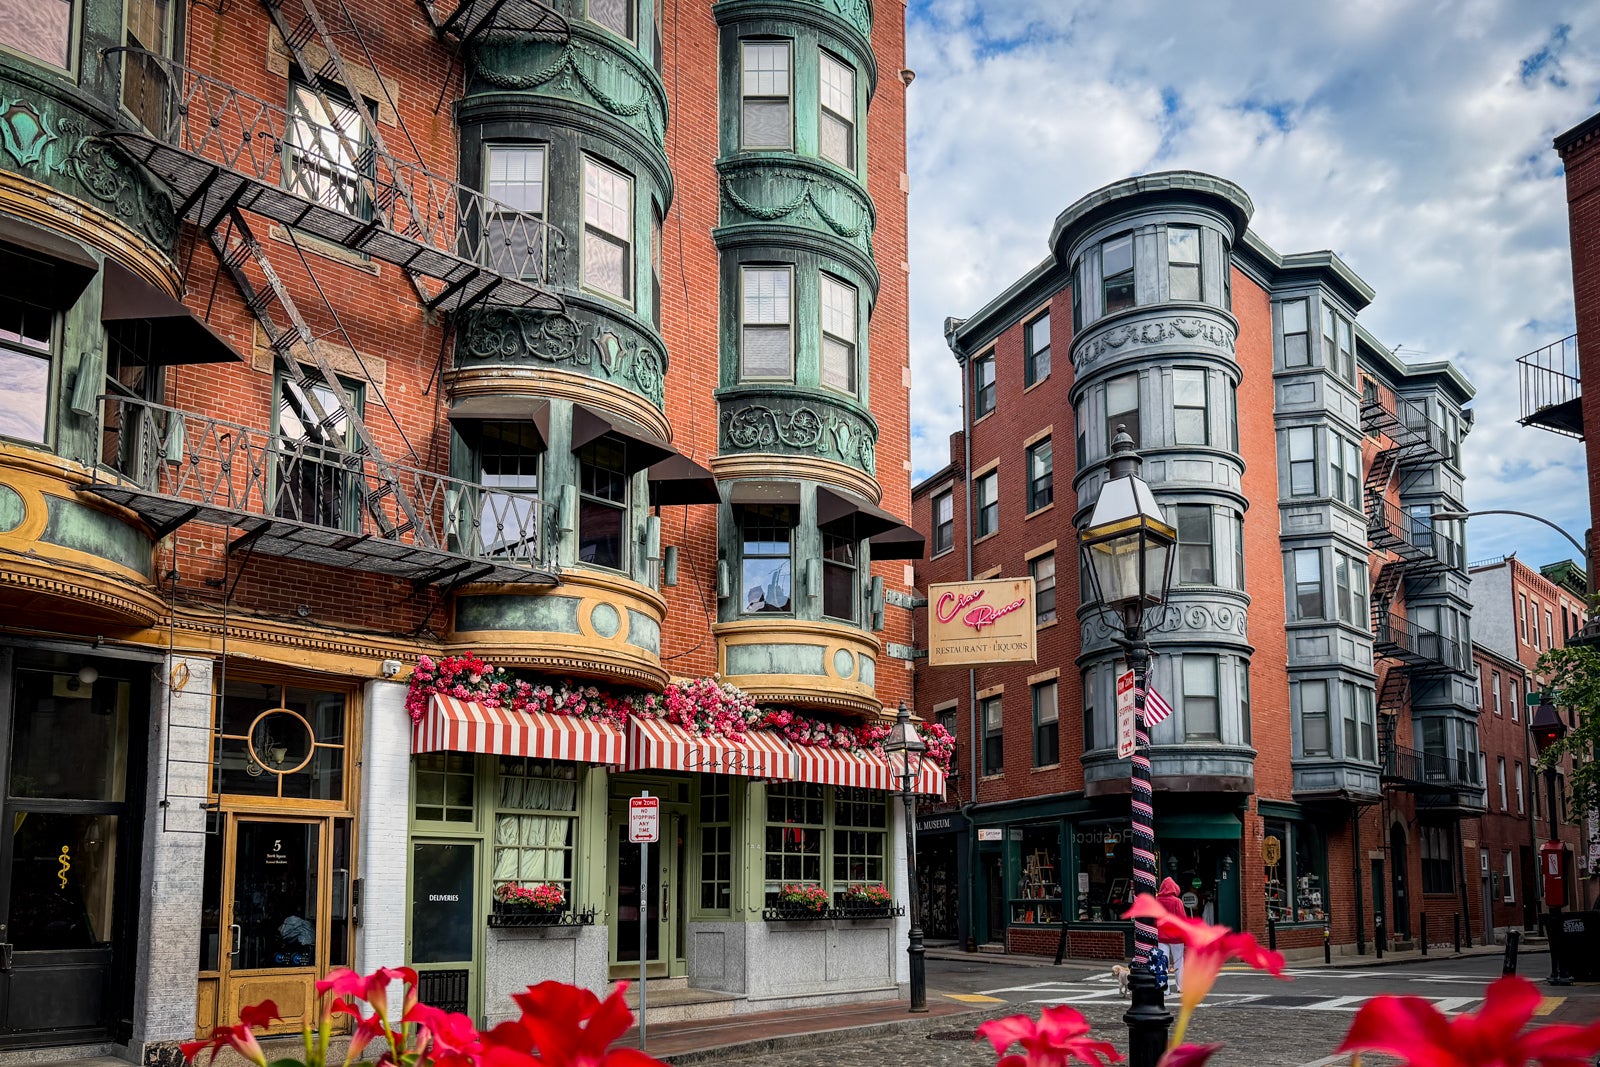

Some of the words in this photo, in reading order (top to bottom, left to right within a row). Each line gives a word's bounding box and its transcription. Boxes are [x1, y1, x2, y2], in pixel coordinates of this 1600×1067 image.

[936, 589, 985, 624] Ciao
[963, 598, 1026, 632] Roma
[935, 645, 988, 655] RESTAURANT
[993, 642, 1028, 653] LIQUORS
[682, 749, 721, 768] Ciao
[721, 750, 766, 773] Roma
[923, 818, 951, 831] MUSEUM
[273, 839, 282, 852] 5
